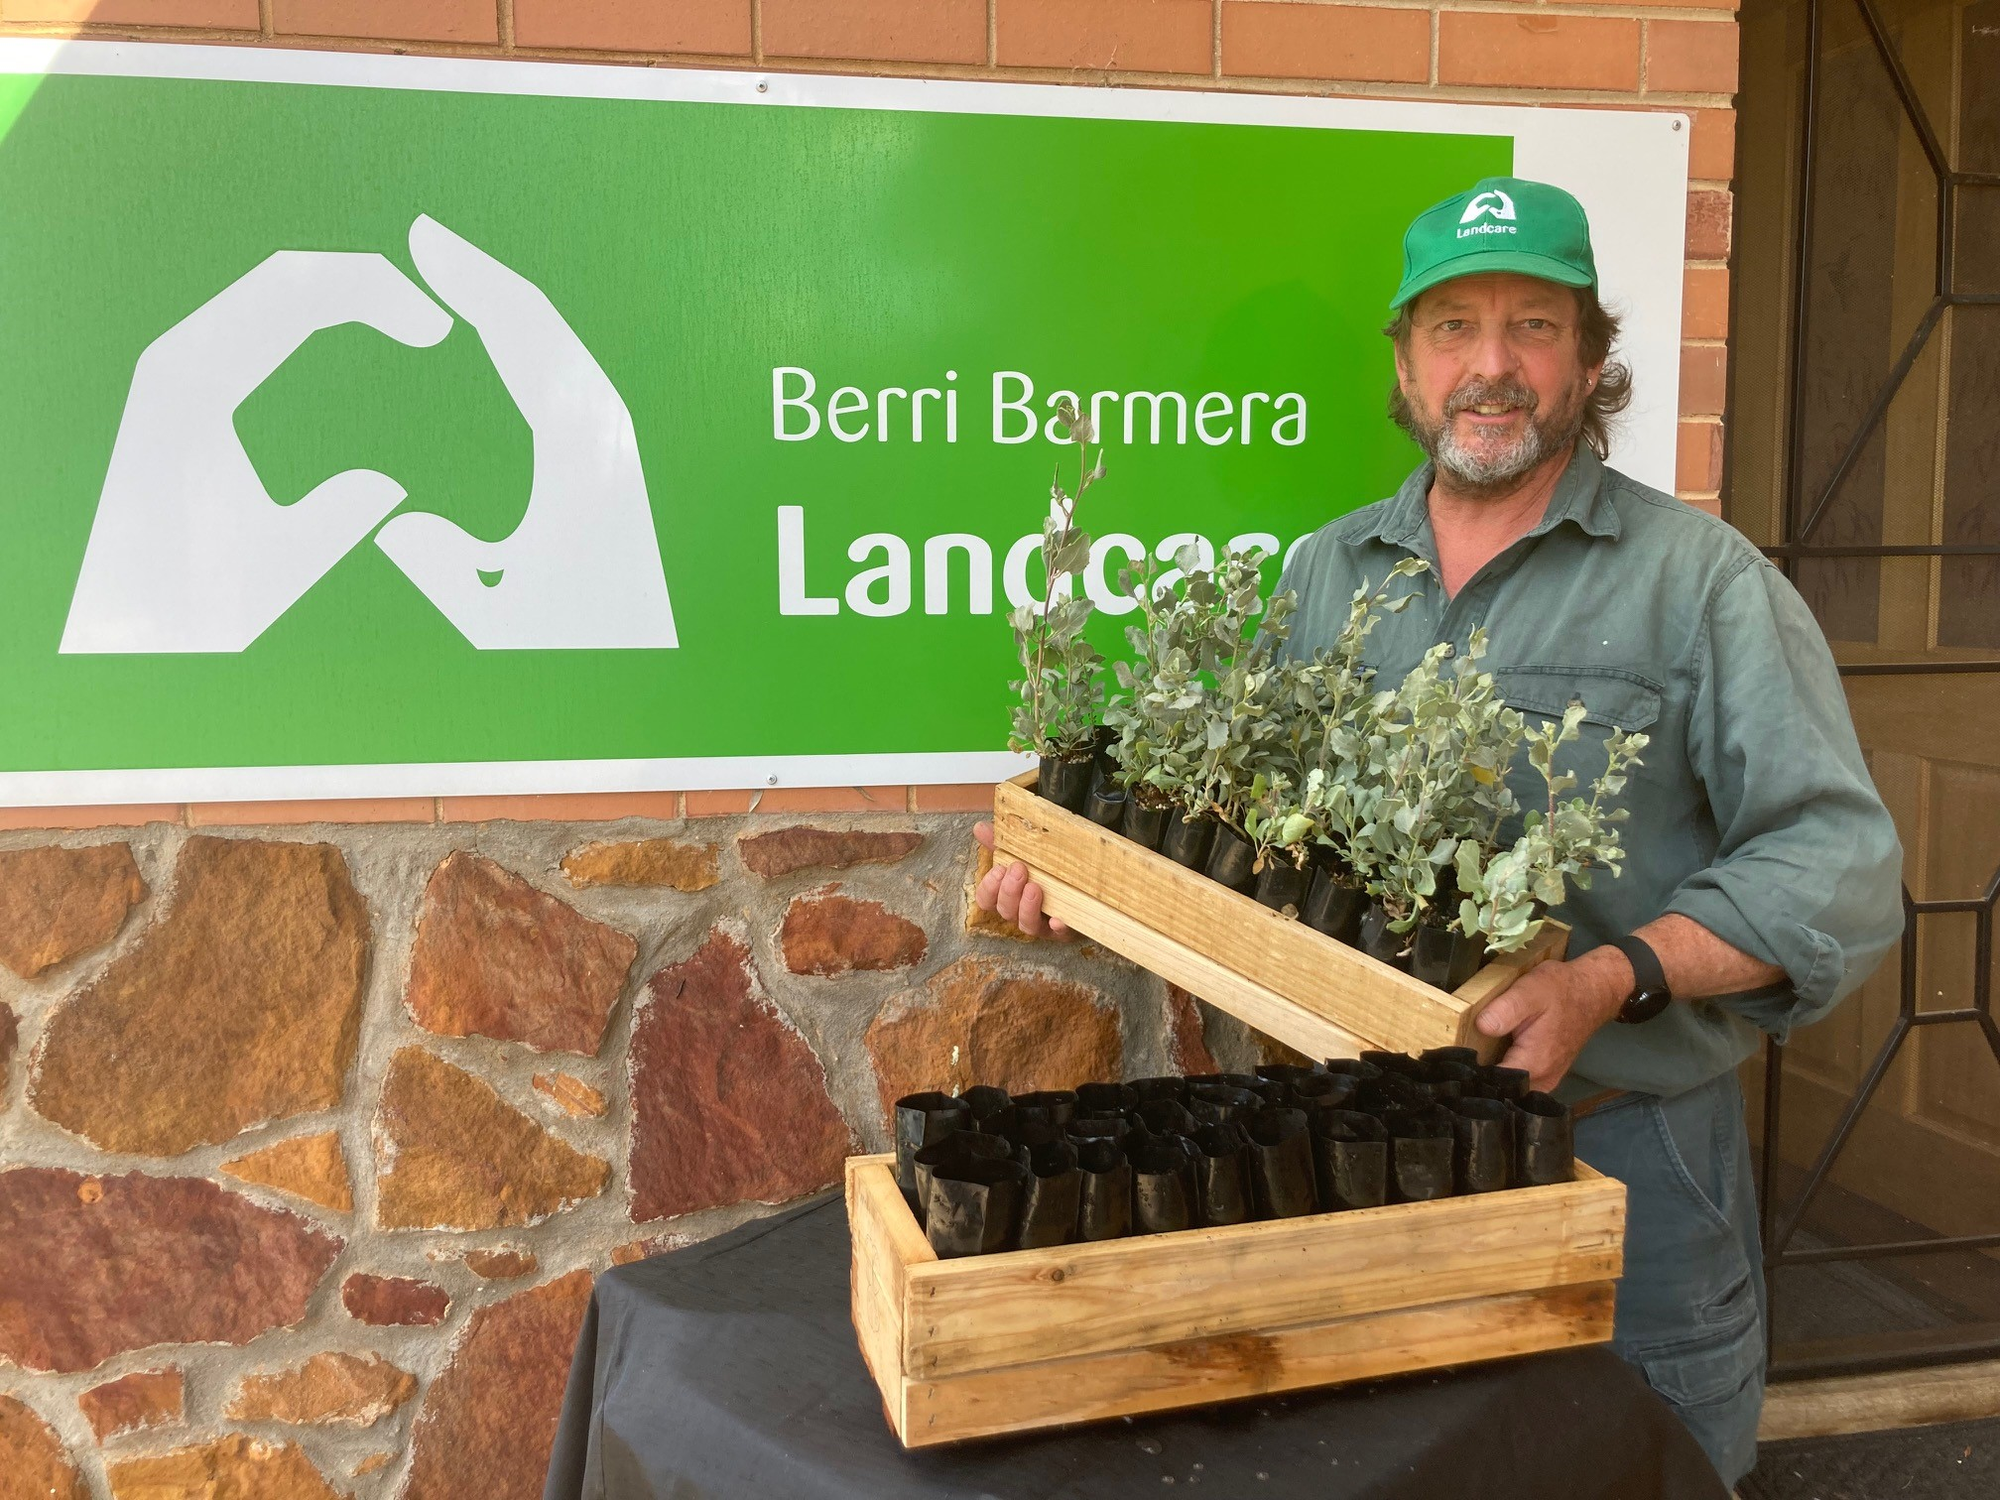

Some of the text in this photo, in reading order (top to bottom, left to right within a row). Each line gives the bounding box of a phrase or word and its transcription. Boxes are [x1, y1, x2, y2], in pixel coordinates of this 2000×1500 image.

[1456, 221, 1517, 239] Landcare
[772, 366, 1307, 446] Berri Barmera
[777, 498, 1315, 617] Landcar
